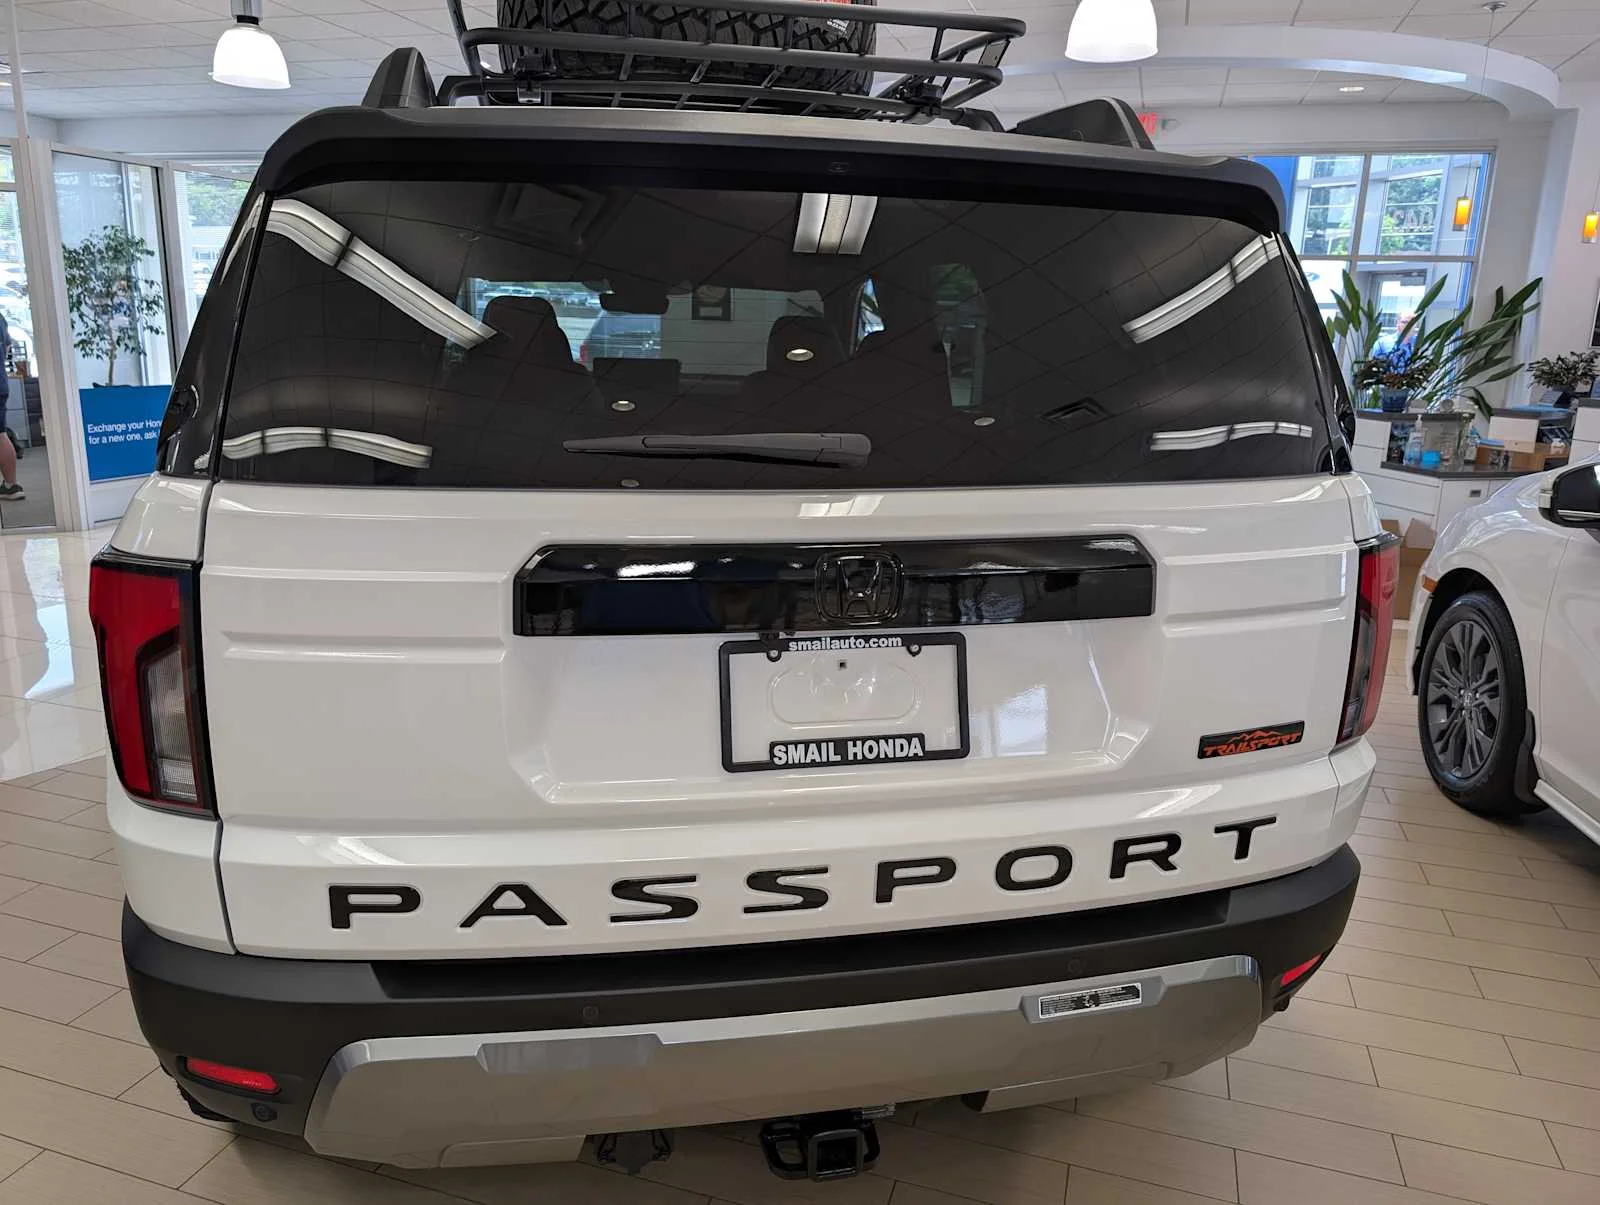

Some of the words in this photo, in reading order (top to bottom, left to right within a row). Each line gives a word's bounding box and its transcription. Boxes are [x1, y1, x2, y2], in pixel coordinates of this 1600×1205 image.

[88, 423, 126, 433] Exchange
[127, 421, 145, 432] your
[89, 436, 100, 445] for
[109, 435, 125, 443] new
[126, 433, 143, 441] one,
[144, 431, 157, 439] ask
[788, 636, 903, 651] smailauto.com
[773, 742, 842, 766] SMAIL
[848, 737, 924, 761] HONDA
[1203, 732, 1301, 755] TRAILSPORT
[329, 816, 1277, 929] PASSPORT
